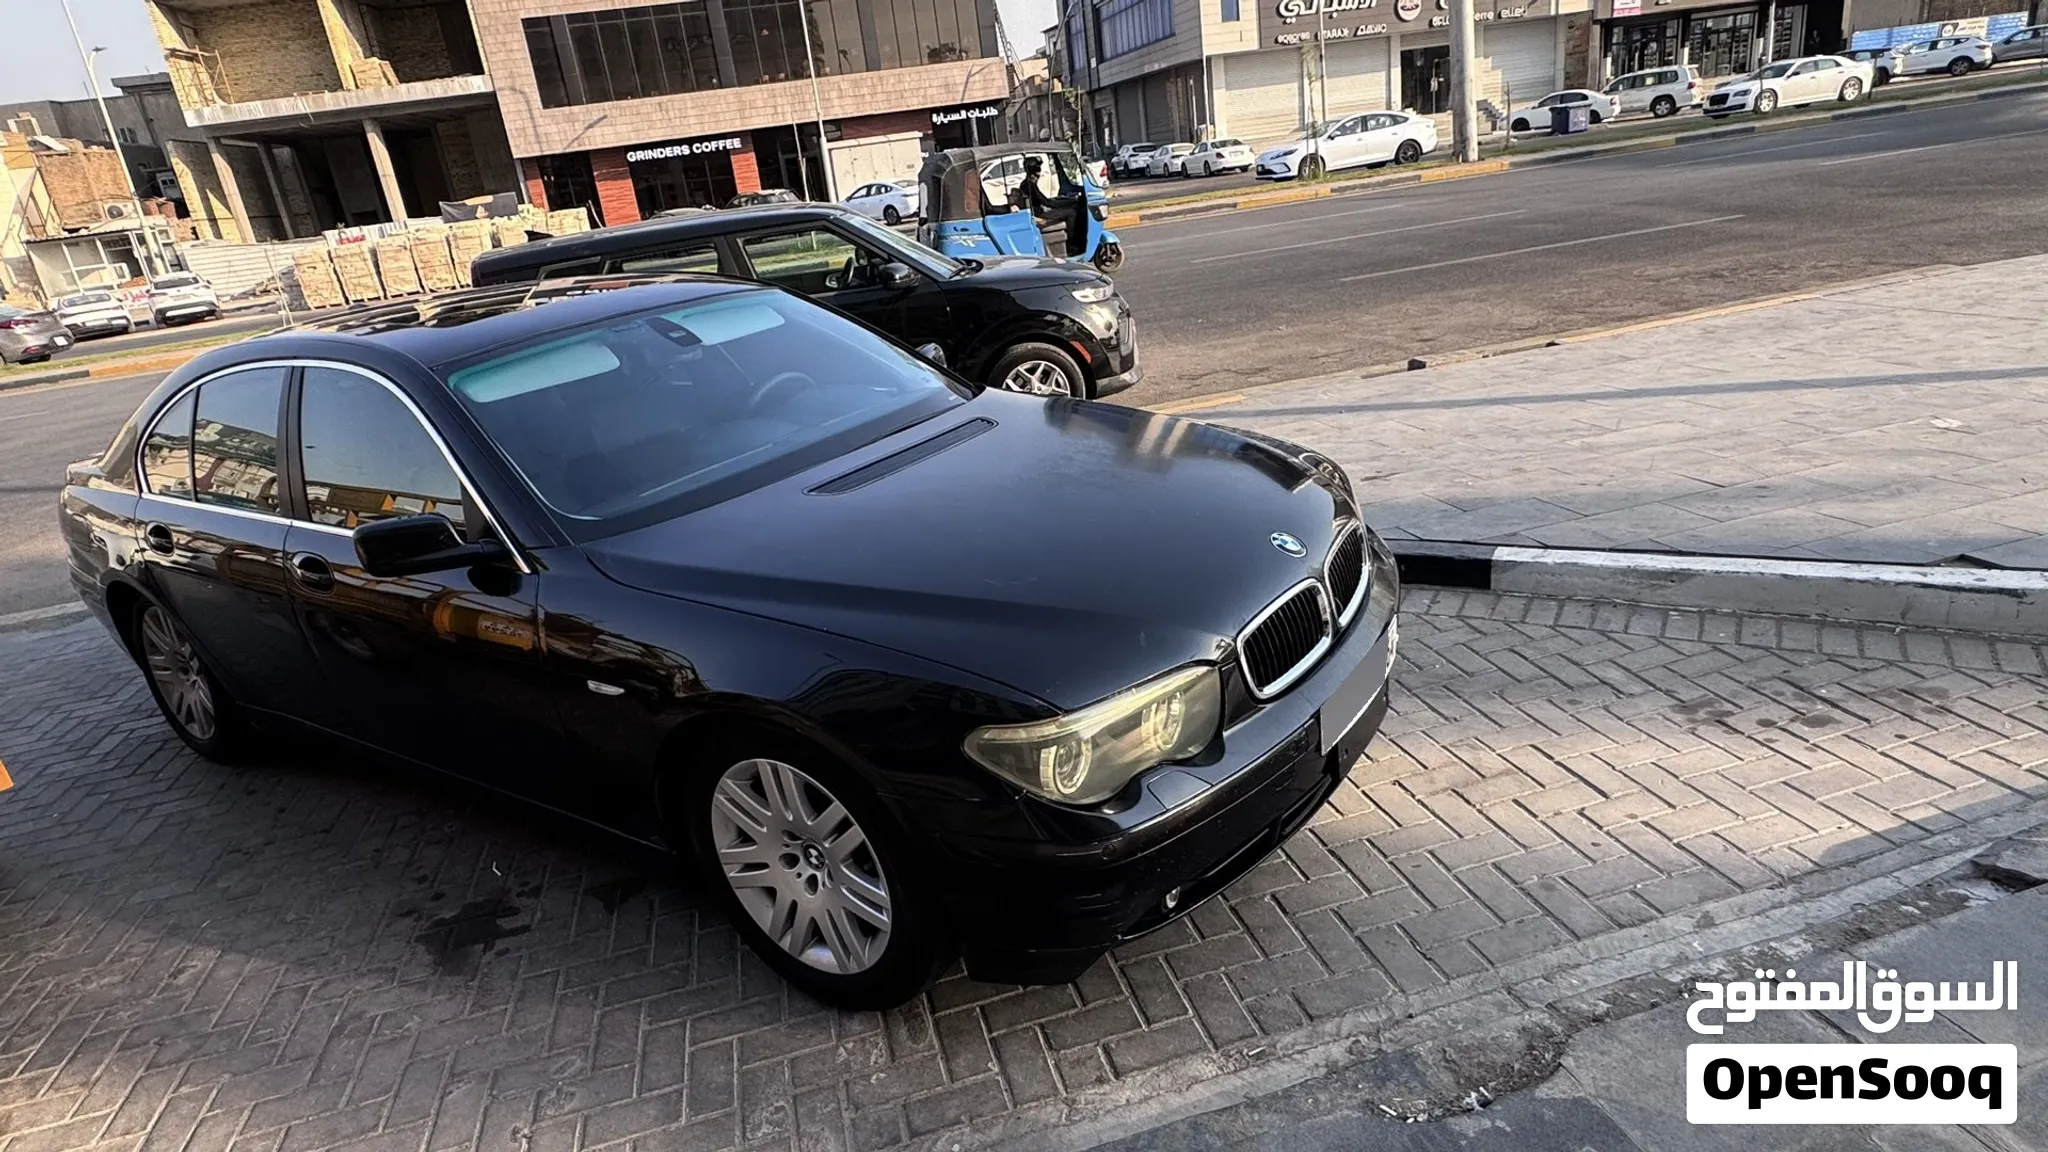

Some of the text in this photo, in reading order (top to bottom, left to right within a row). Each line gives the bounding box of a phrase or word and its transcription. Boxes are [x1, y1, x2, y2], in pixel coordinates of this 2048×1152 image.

[932, 106, 999, 125] طلبات السيارة
[626, 137, 742, 162] GRINDERS COFFEE
